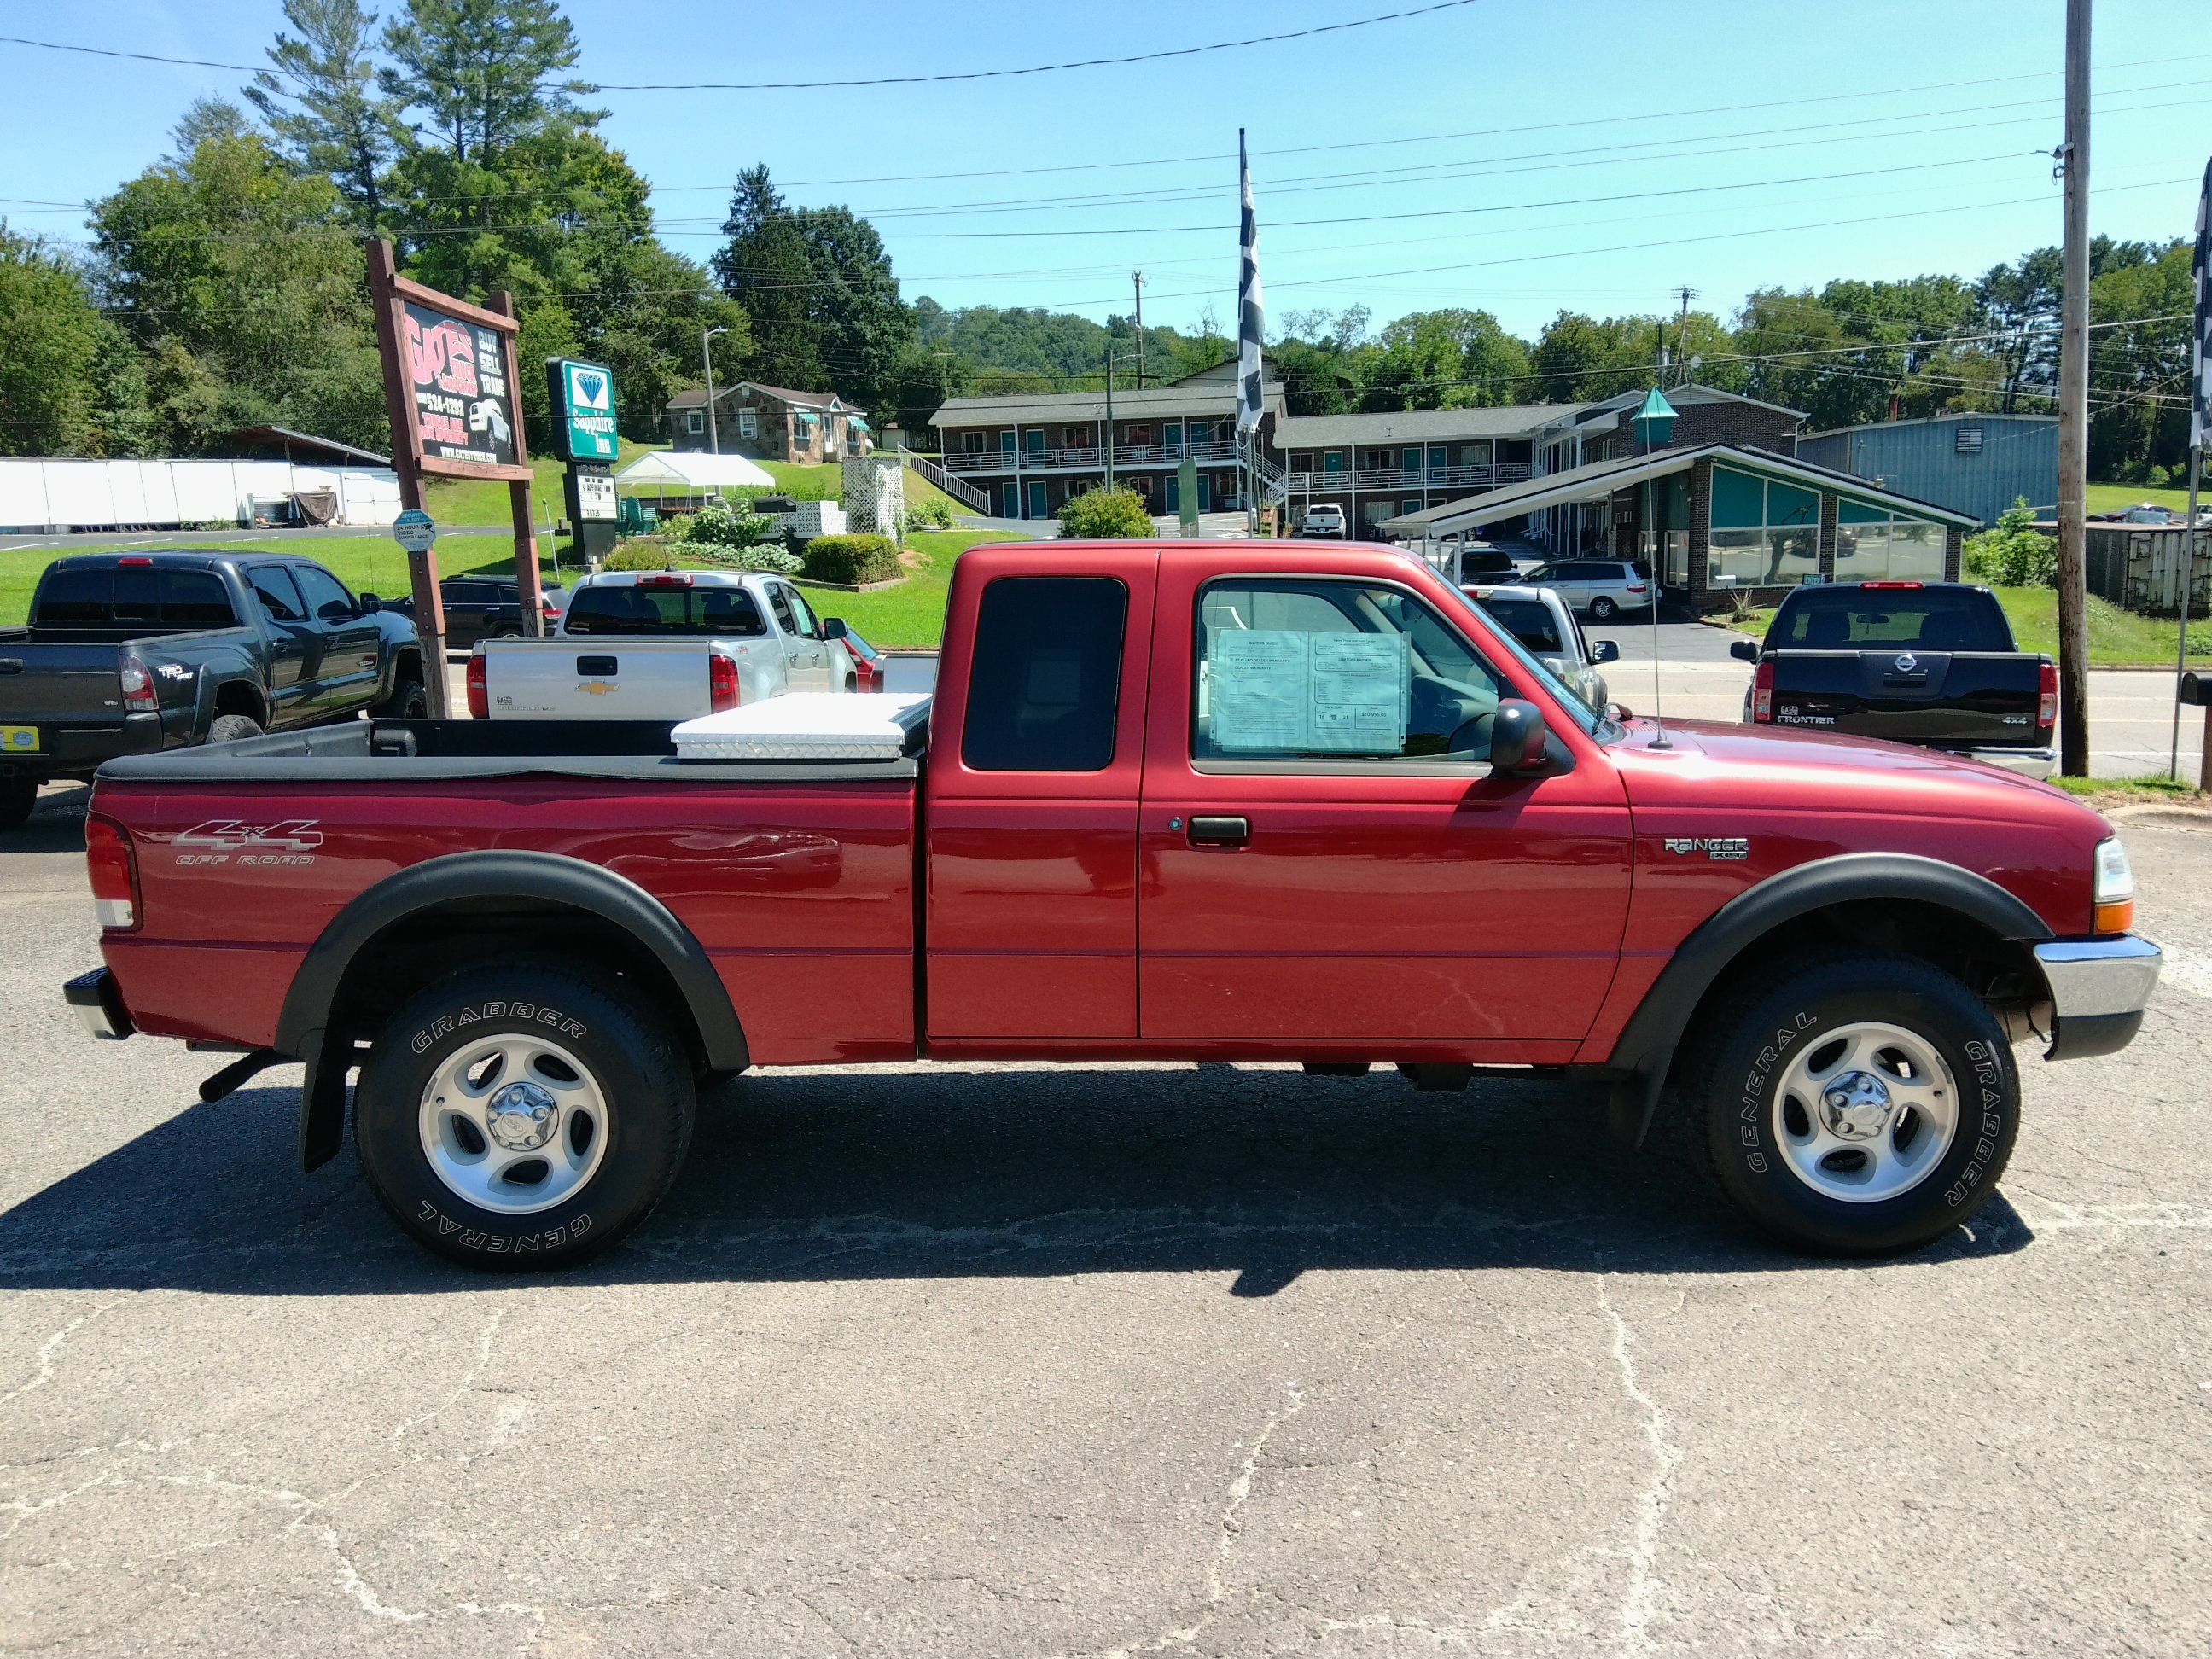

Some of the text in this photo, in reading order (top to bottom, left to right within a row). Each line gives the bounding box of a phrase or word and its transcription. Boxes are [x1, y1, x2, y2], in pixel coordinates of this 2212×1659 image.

[405, 312, 474, 385] GATES
[478, 330, 497, 353] BUY
[479, 352, 502, 375] SELL
[480, 374, 504, 397] TRADE
[573, 408, 614, 435] Sapphire
[596, 433, 612, 454] Inn
[158, 665, 183, 678] TRD
[1777, 715, 1835, 725] FRONTIER
[176, 855, 315, 865] OFF ROAD
[411, 1001, 587, 1054] GRABBER
[1741, 1012, 1818, 1173] GENERAL
[1944, 1040, 2000, 1207] GRABBER
[417, 1199, 591, 1253] GENERAL
